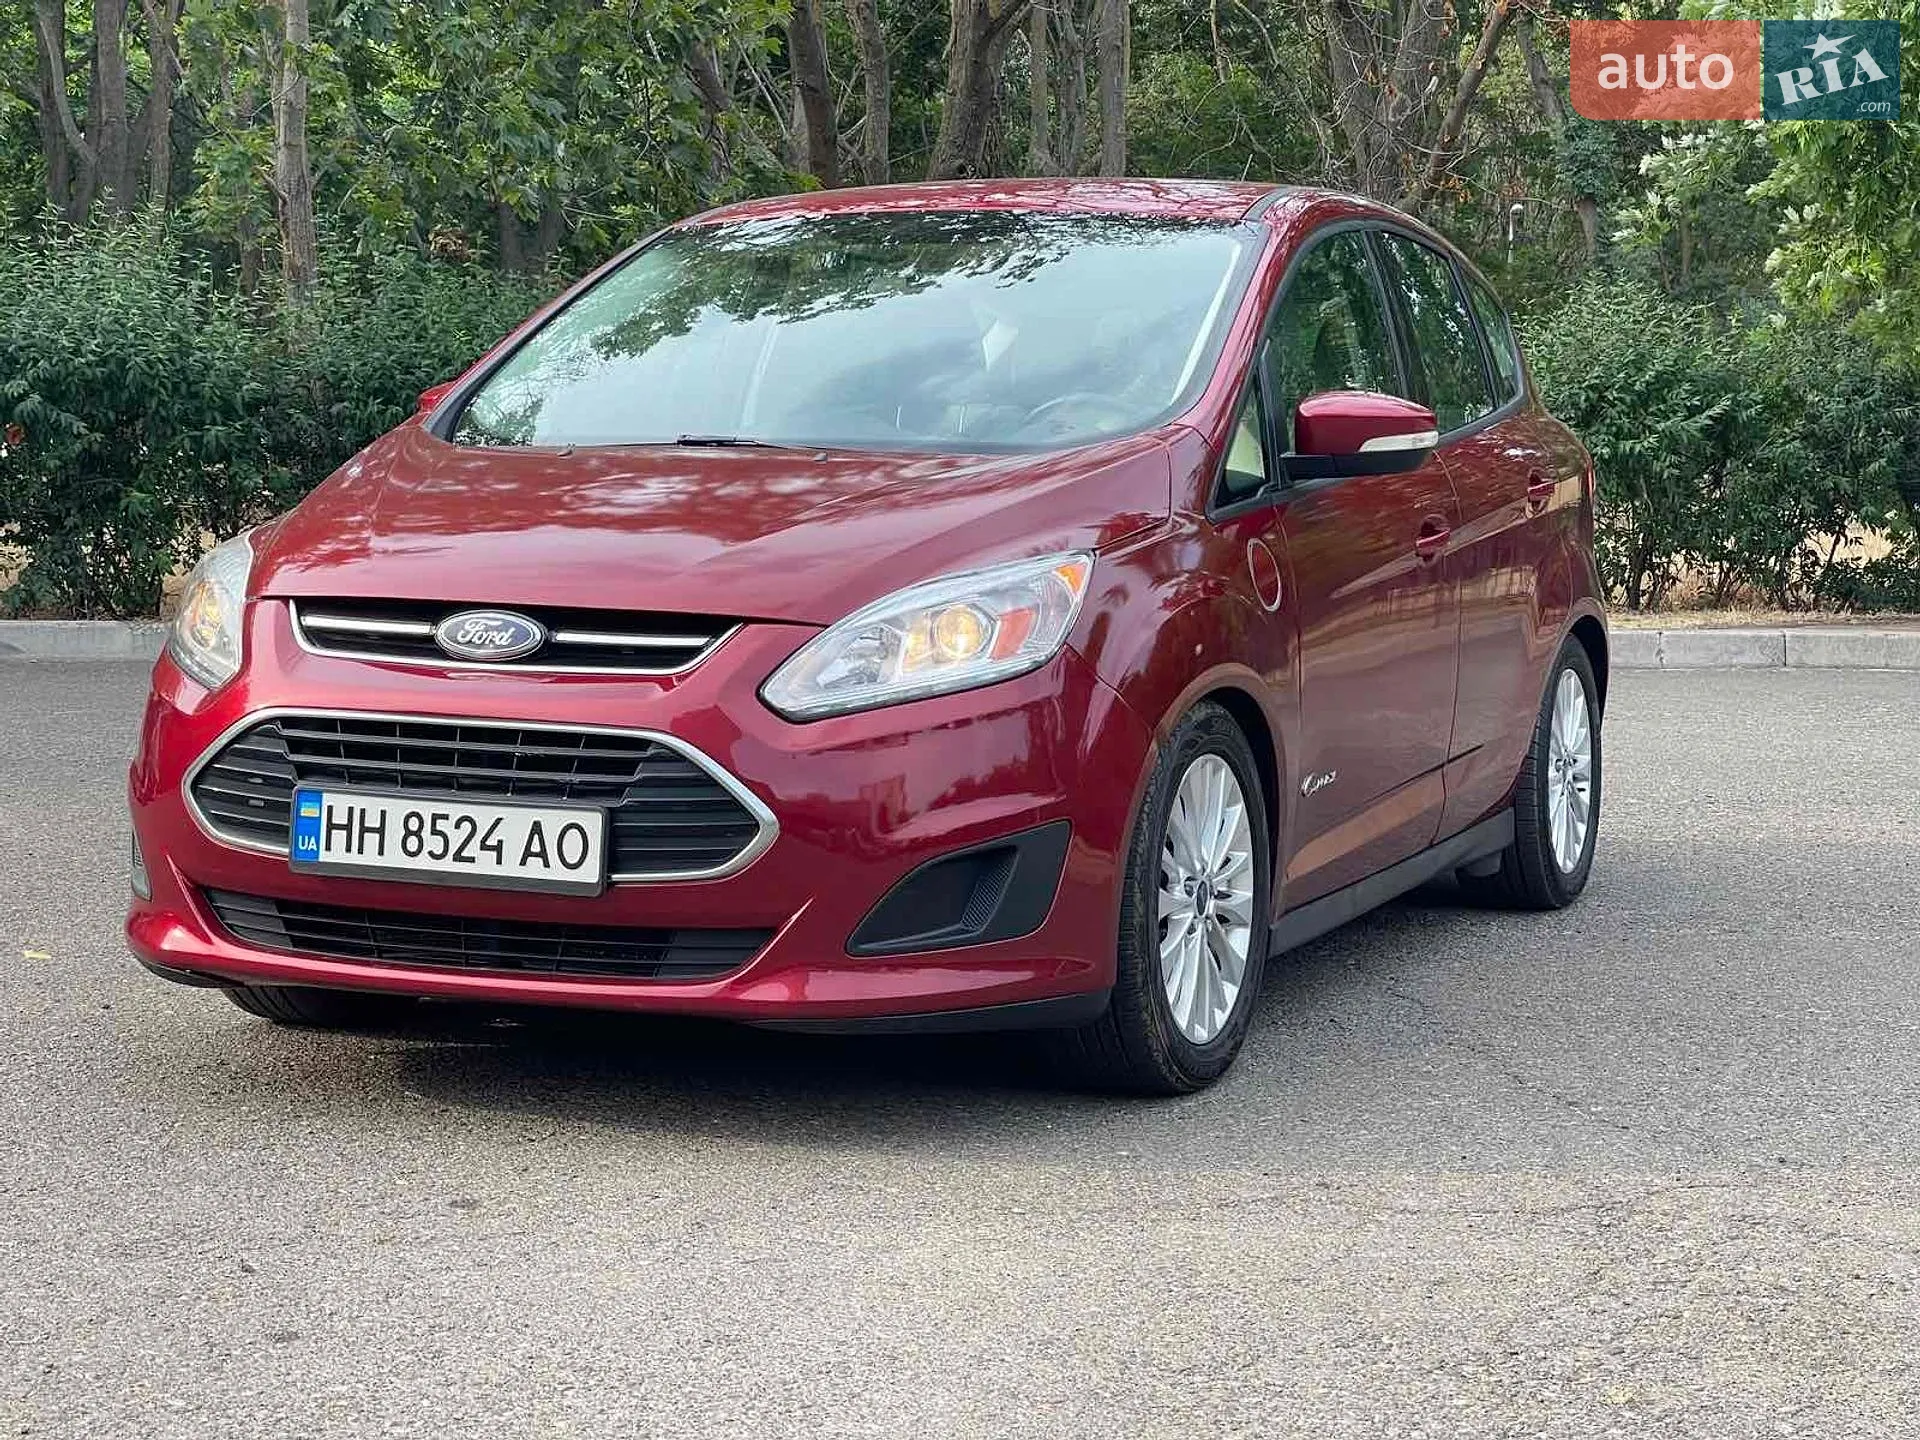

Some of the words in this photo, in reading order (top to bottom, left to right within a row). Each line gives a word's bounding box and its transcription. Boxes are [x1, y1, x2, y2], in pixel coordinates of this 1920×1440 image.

[457, 619, 516, 646] Ford
[298, 835, 318, 852] UA
[324, 804, 387, 856] HH
[400, 810, 504, 866] 8524
[519, 819, 589, 870] AO
